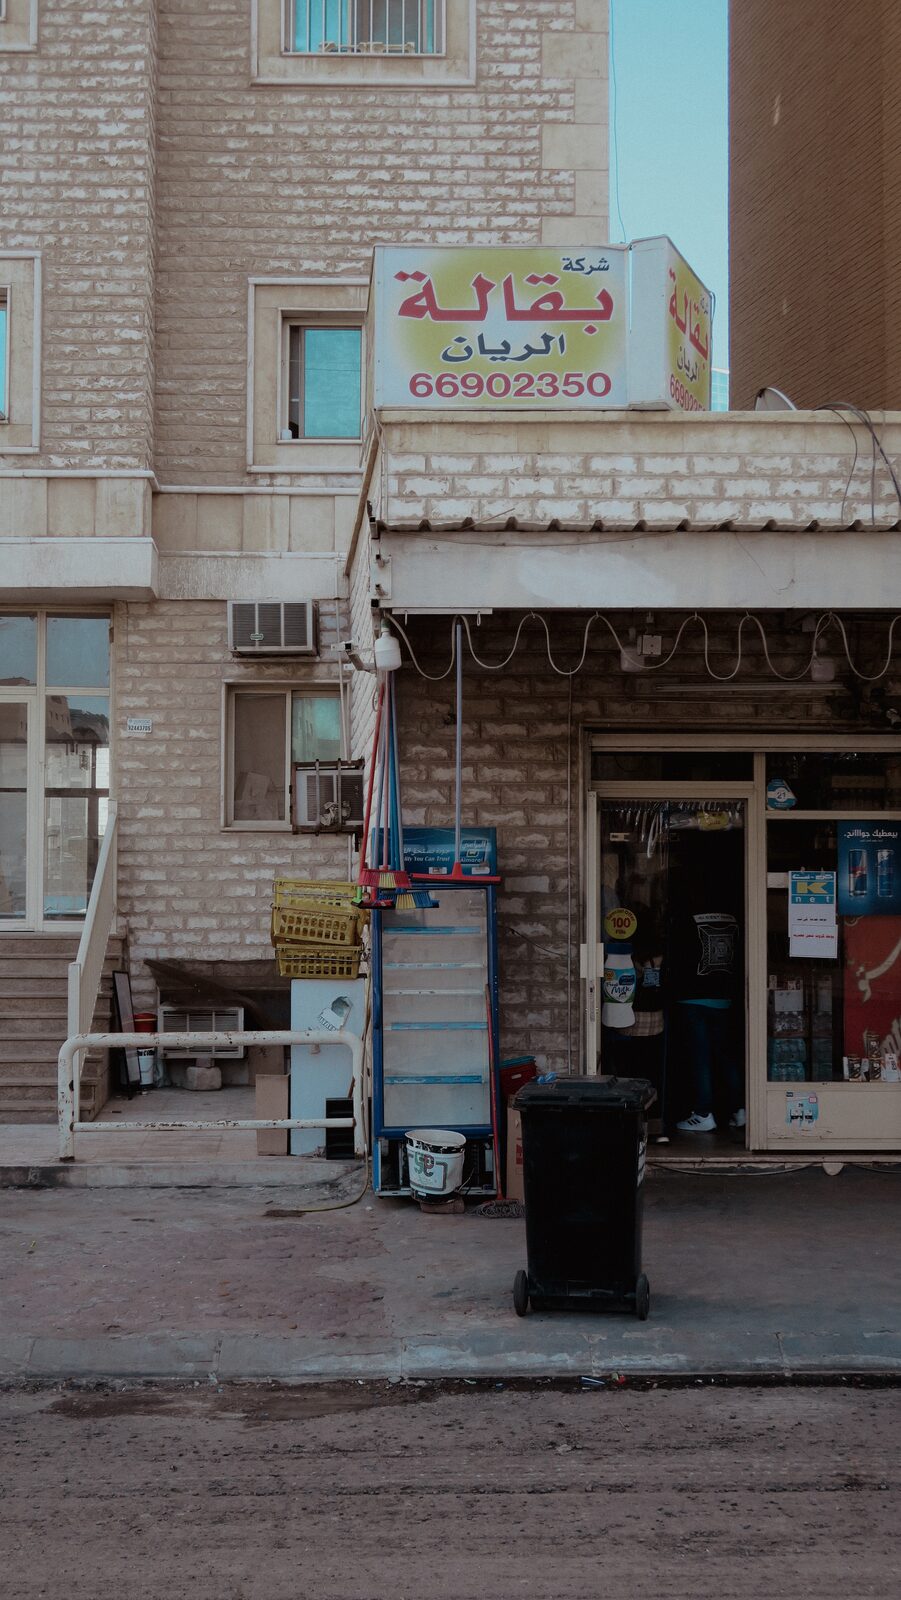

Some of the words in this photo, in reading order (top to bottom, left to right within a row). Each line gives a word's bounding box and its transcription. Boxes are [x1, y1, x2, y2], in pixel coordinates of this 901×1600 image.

[561, 257, 610, 276] شركة
[393, 270, 614, 335] بقالة
[668, 268, 709, 371] بقالة
[440, 332, 566, 363] الريان
[408, 371, 612, 398] 66902350
[669, 374, 705, 411] 669023
[797, 881, 828, 894] K
[610, 917, 631, 928] 100
